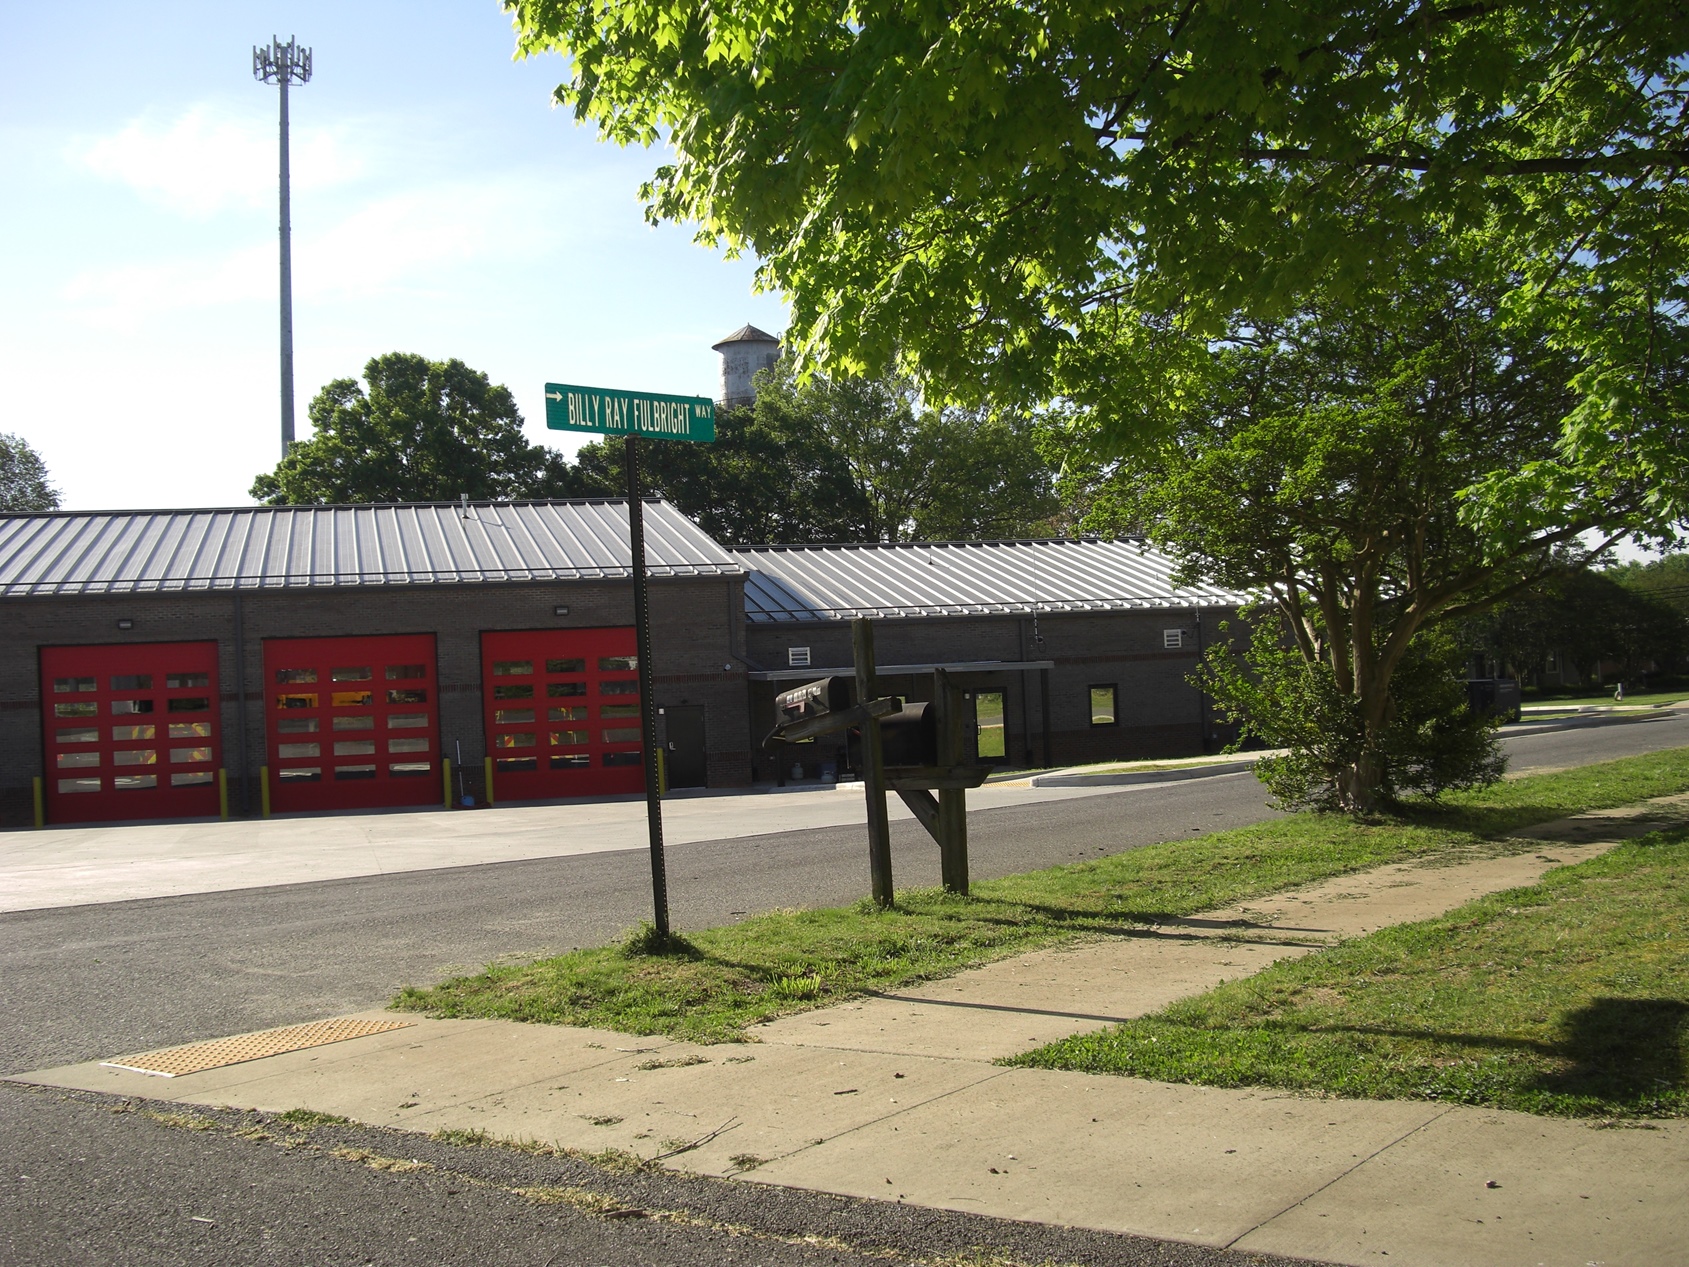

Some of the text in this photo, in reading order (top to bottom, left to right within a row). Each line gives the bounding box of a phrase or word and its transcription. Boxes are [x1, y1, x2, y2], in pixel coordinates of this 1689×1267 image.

[568, 392, 711, 434] BILLY RAY FULBRIGHT WAY
